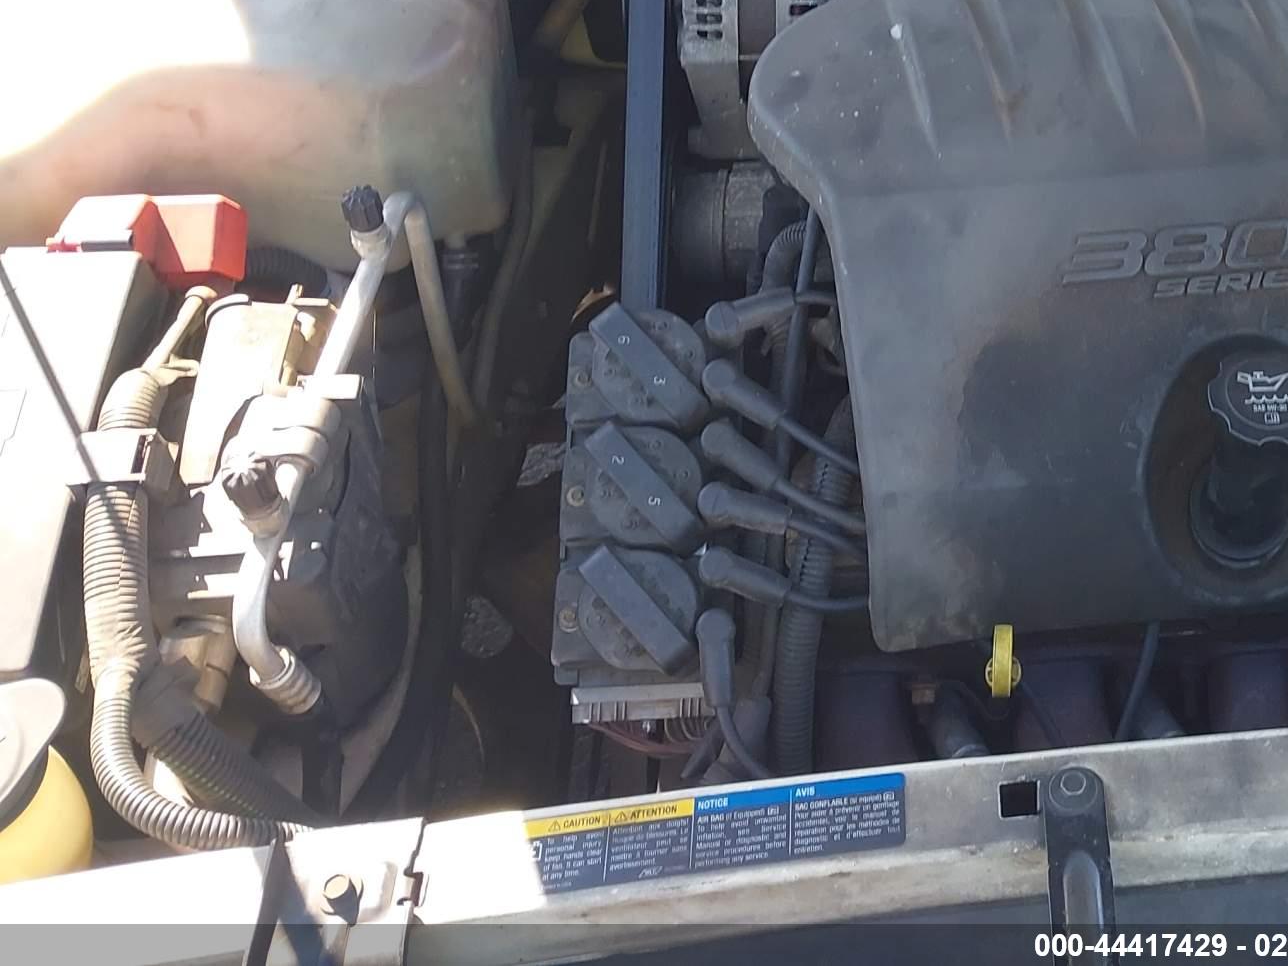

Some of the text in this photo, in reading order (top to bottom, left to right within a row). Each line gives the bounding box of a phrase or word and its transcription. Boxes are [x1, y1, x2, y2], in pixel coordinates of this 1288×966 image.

[795, 786, 815, 798] AVIS
[697, 797, 729, 810] NOTICE
[630, 804, 678, 820] ATTENTION
[563, 816, 601, 829] CAUTION
